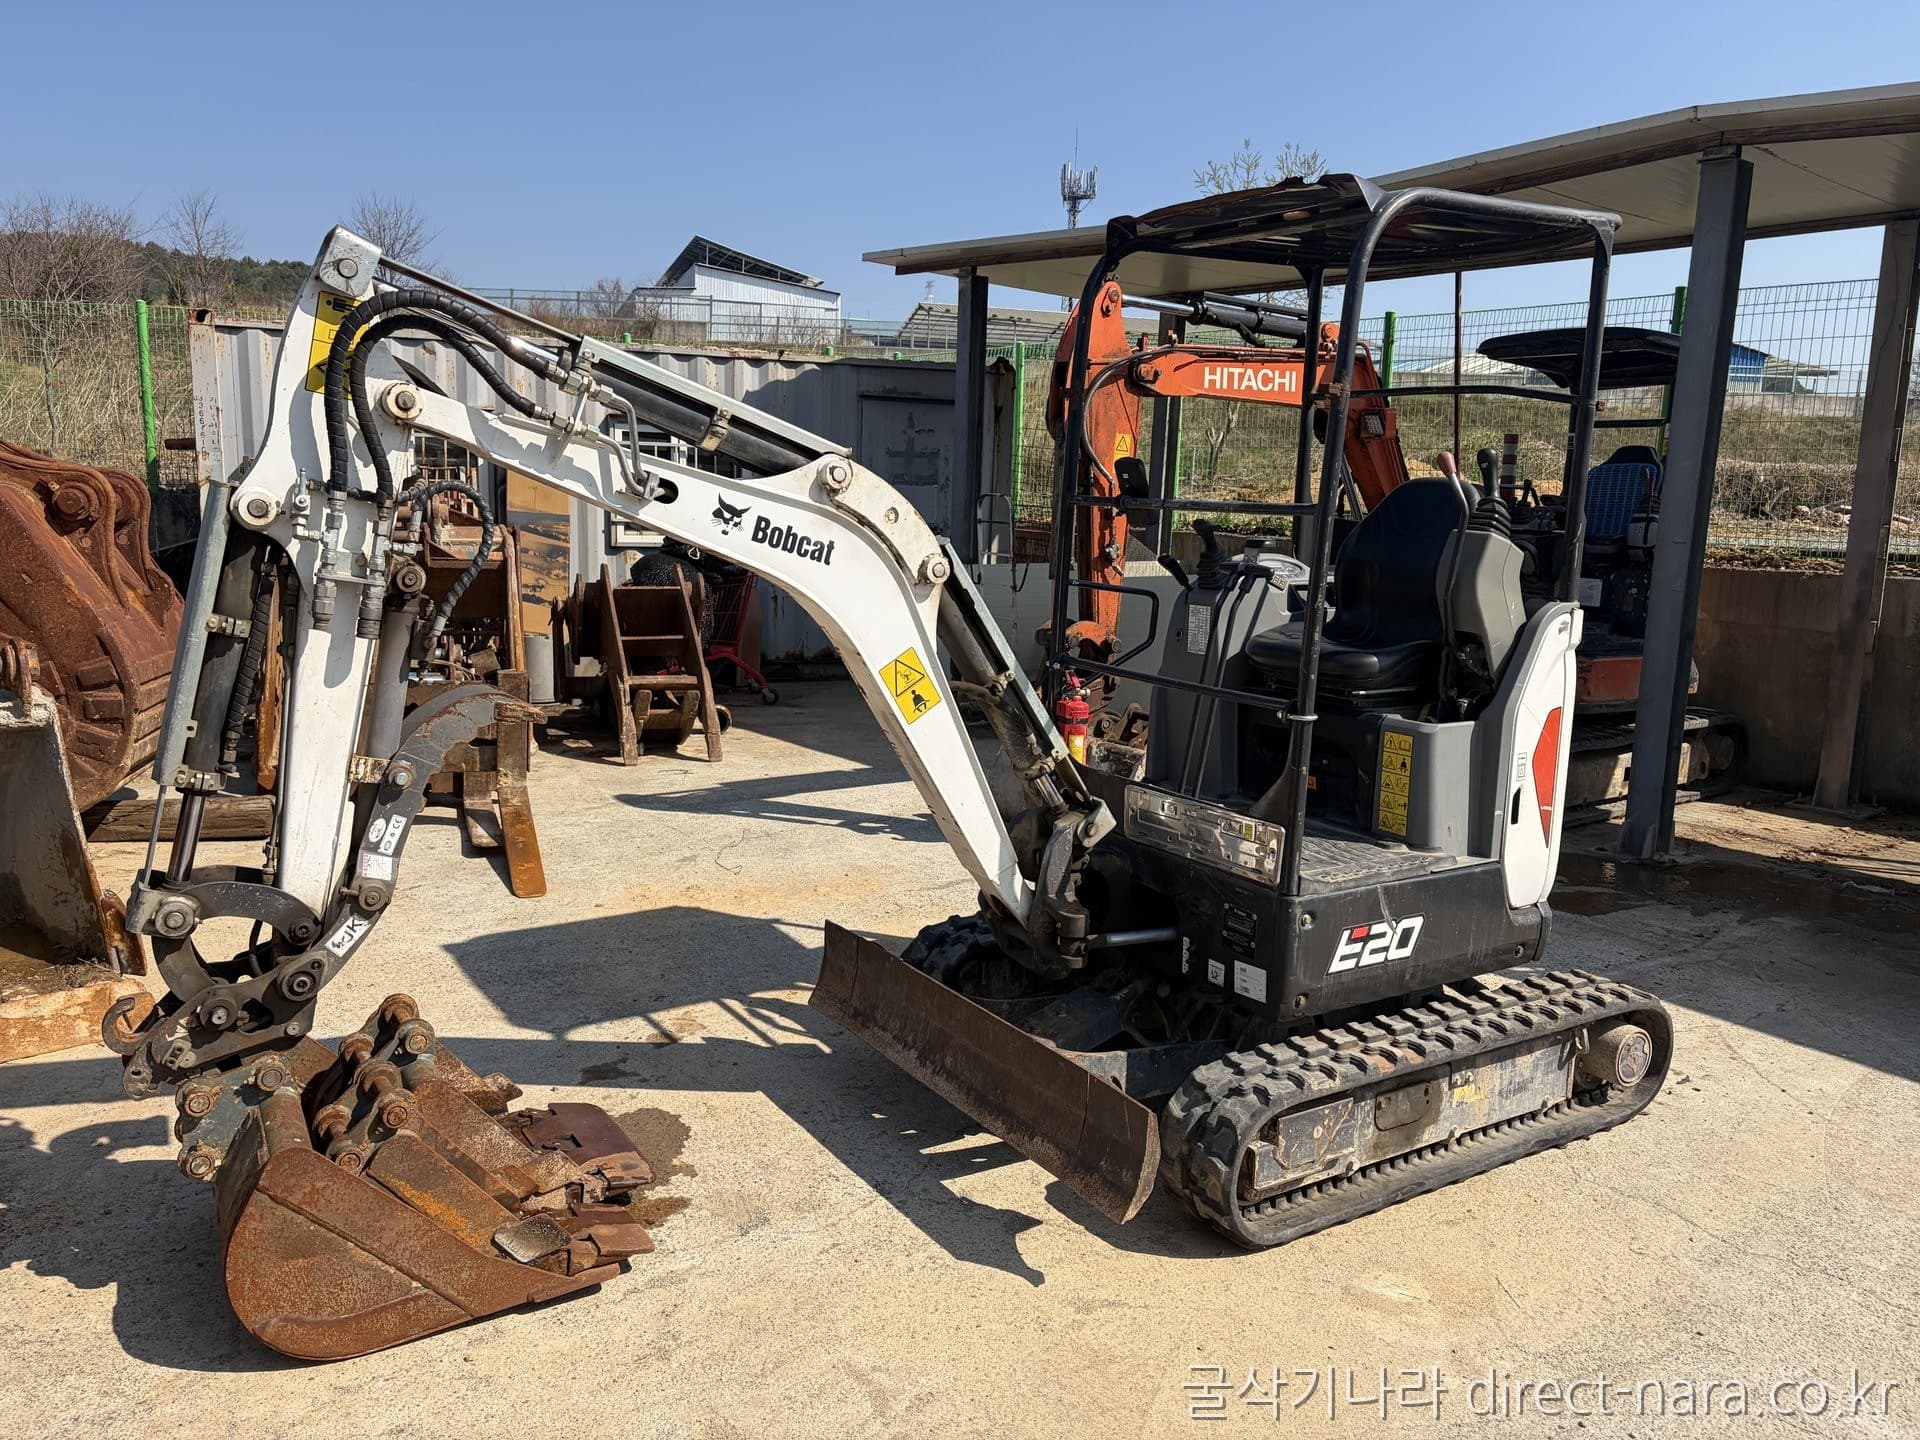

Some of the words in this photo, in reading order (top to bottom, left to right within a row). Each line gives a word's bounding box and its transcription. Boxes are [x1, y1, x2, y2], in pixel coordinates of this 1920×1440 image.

[1203, 366, 1297, 393] HITACHI
[751, 514, 835, 566] Bobcat
[1327, 915, 1424, 974] E20
